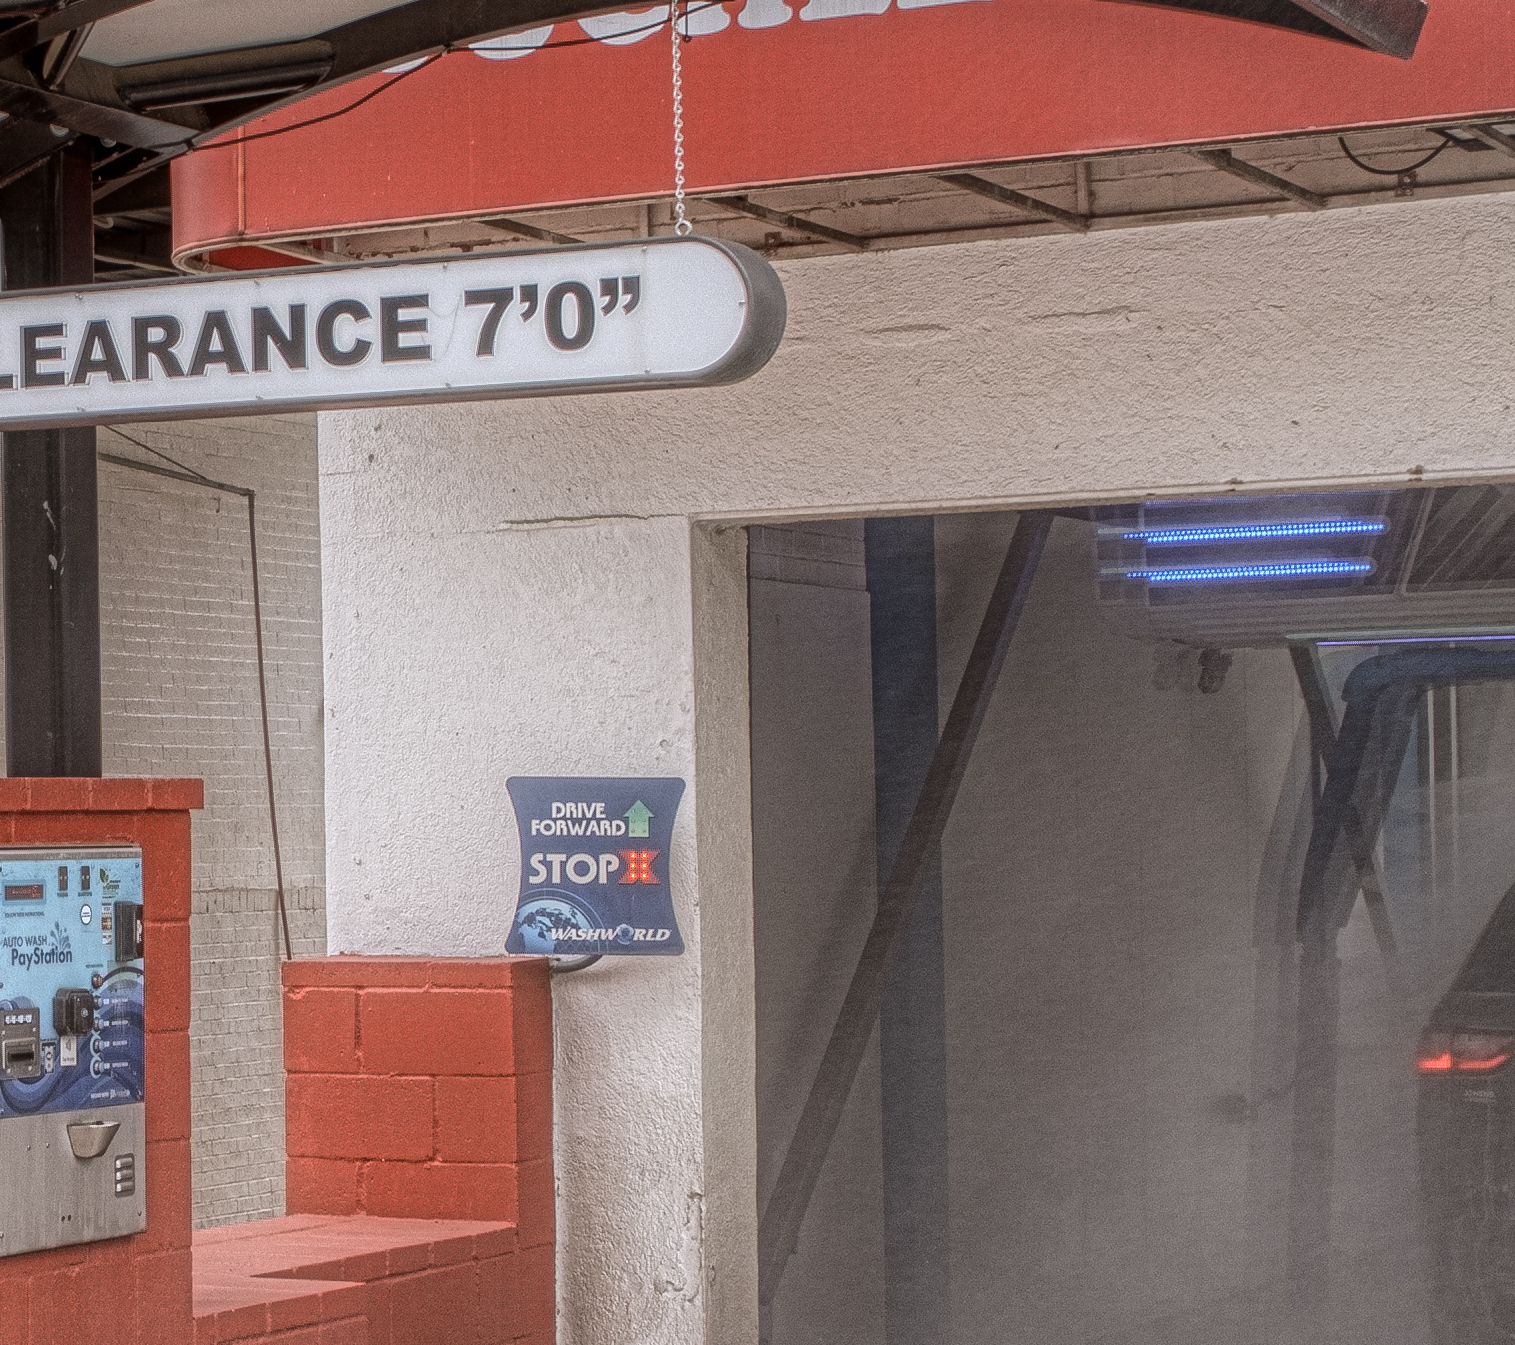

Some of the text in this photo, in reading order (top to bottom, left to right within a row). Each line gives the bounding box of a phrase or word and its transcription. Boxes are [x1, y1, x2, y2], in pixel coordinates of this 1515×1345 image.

[551, 801, 607, 819] DRIVE
[531, 819, 627, 837] FORWARD
[528, 852, 620, 885] STOP
[2, 935, 48, 948] AUTO WASH
[551, 924, 672, 945] WASHWORLD
[12, 946, 73, 971] PayStation
